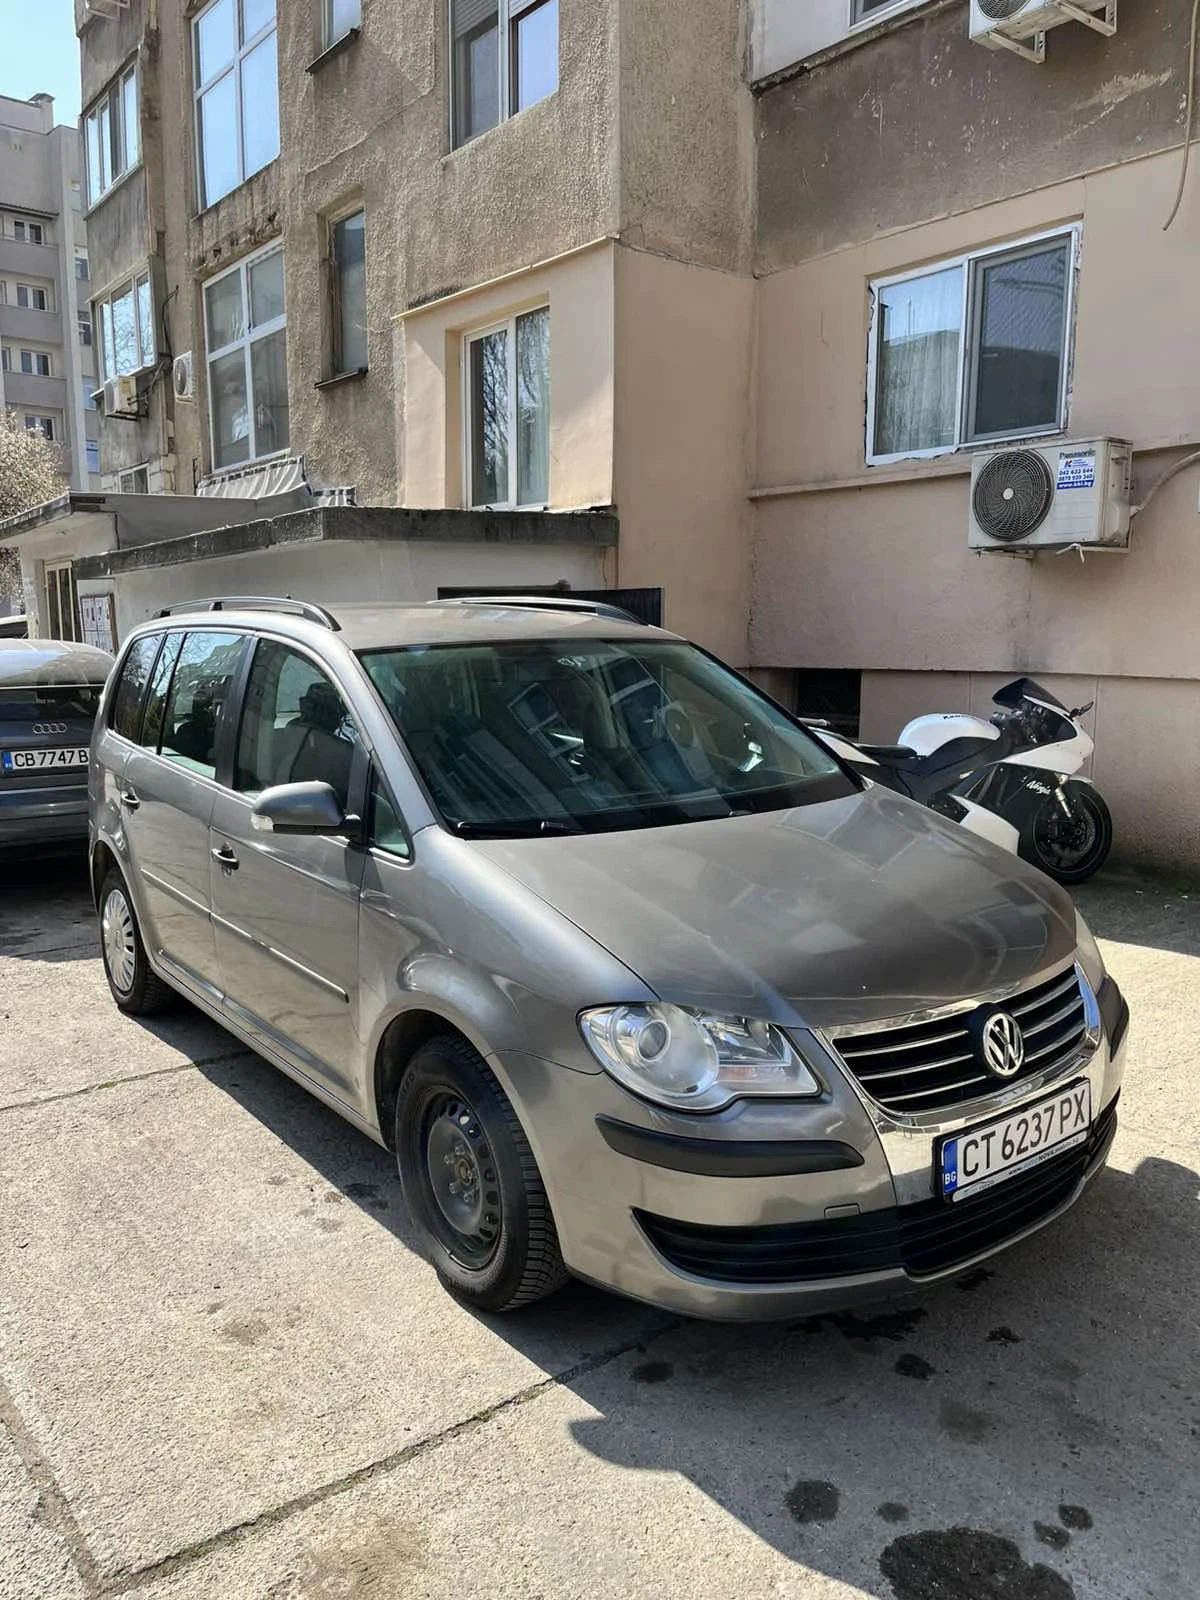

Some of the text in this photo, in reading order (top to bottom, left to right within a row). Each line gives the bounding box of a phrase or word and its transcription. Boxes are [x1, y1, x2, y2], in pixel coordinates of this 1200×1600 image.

[1059, 448, 1096, 460] Panasonic
[14, 752, 36, 768] CB
[37, 750, 75, 766] 7747
[1026, 780, 1051, 795] Ninja
[962, 1130, 996, 1178] CT
[1001, 1104, 1056, 1161] 6237
[1059, 1089, 1086, 1135] PX
[944, 1170, 957, 1185] BG
